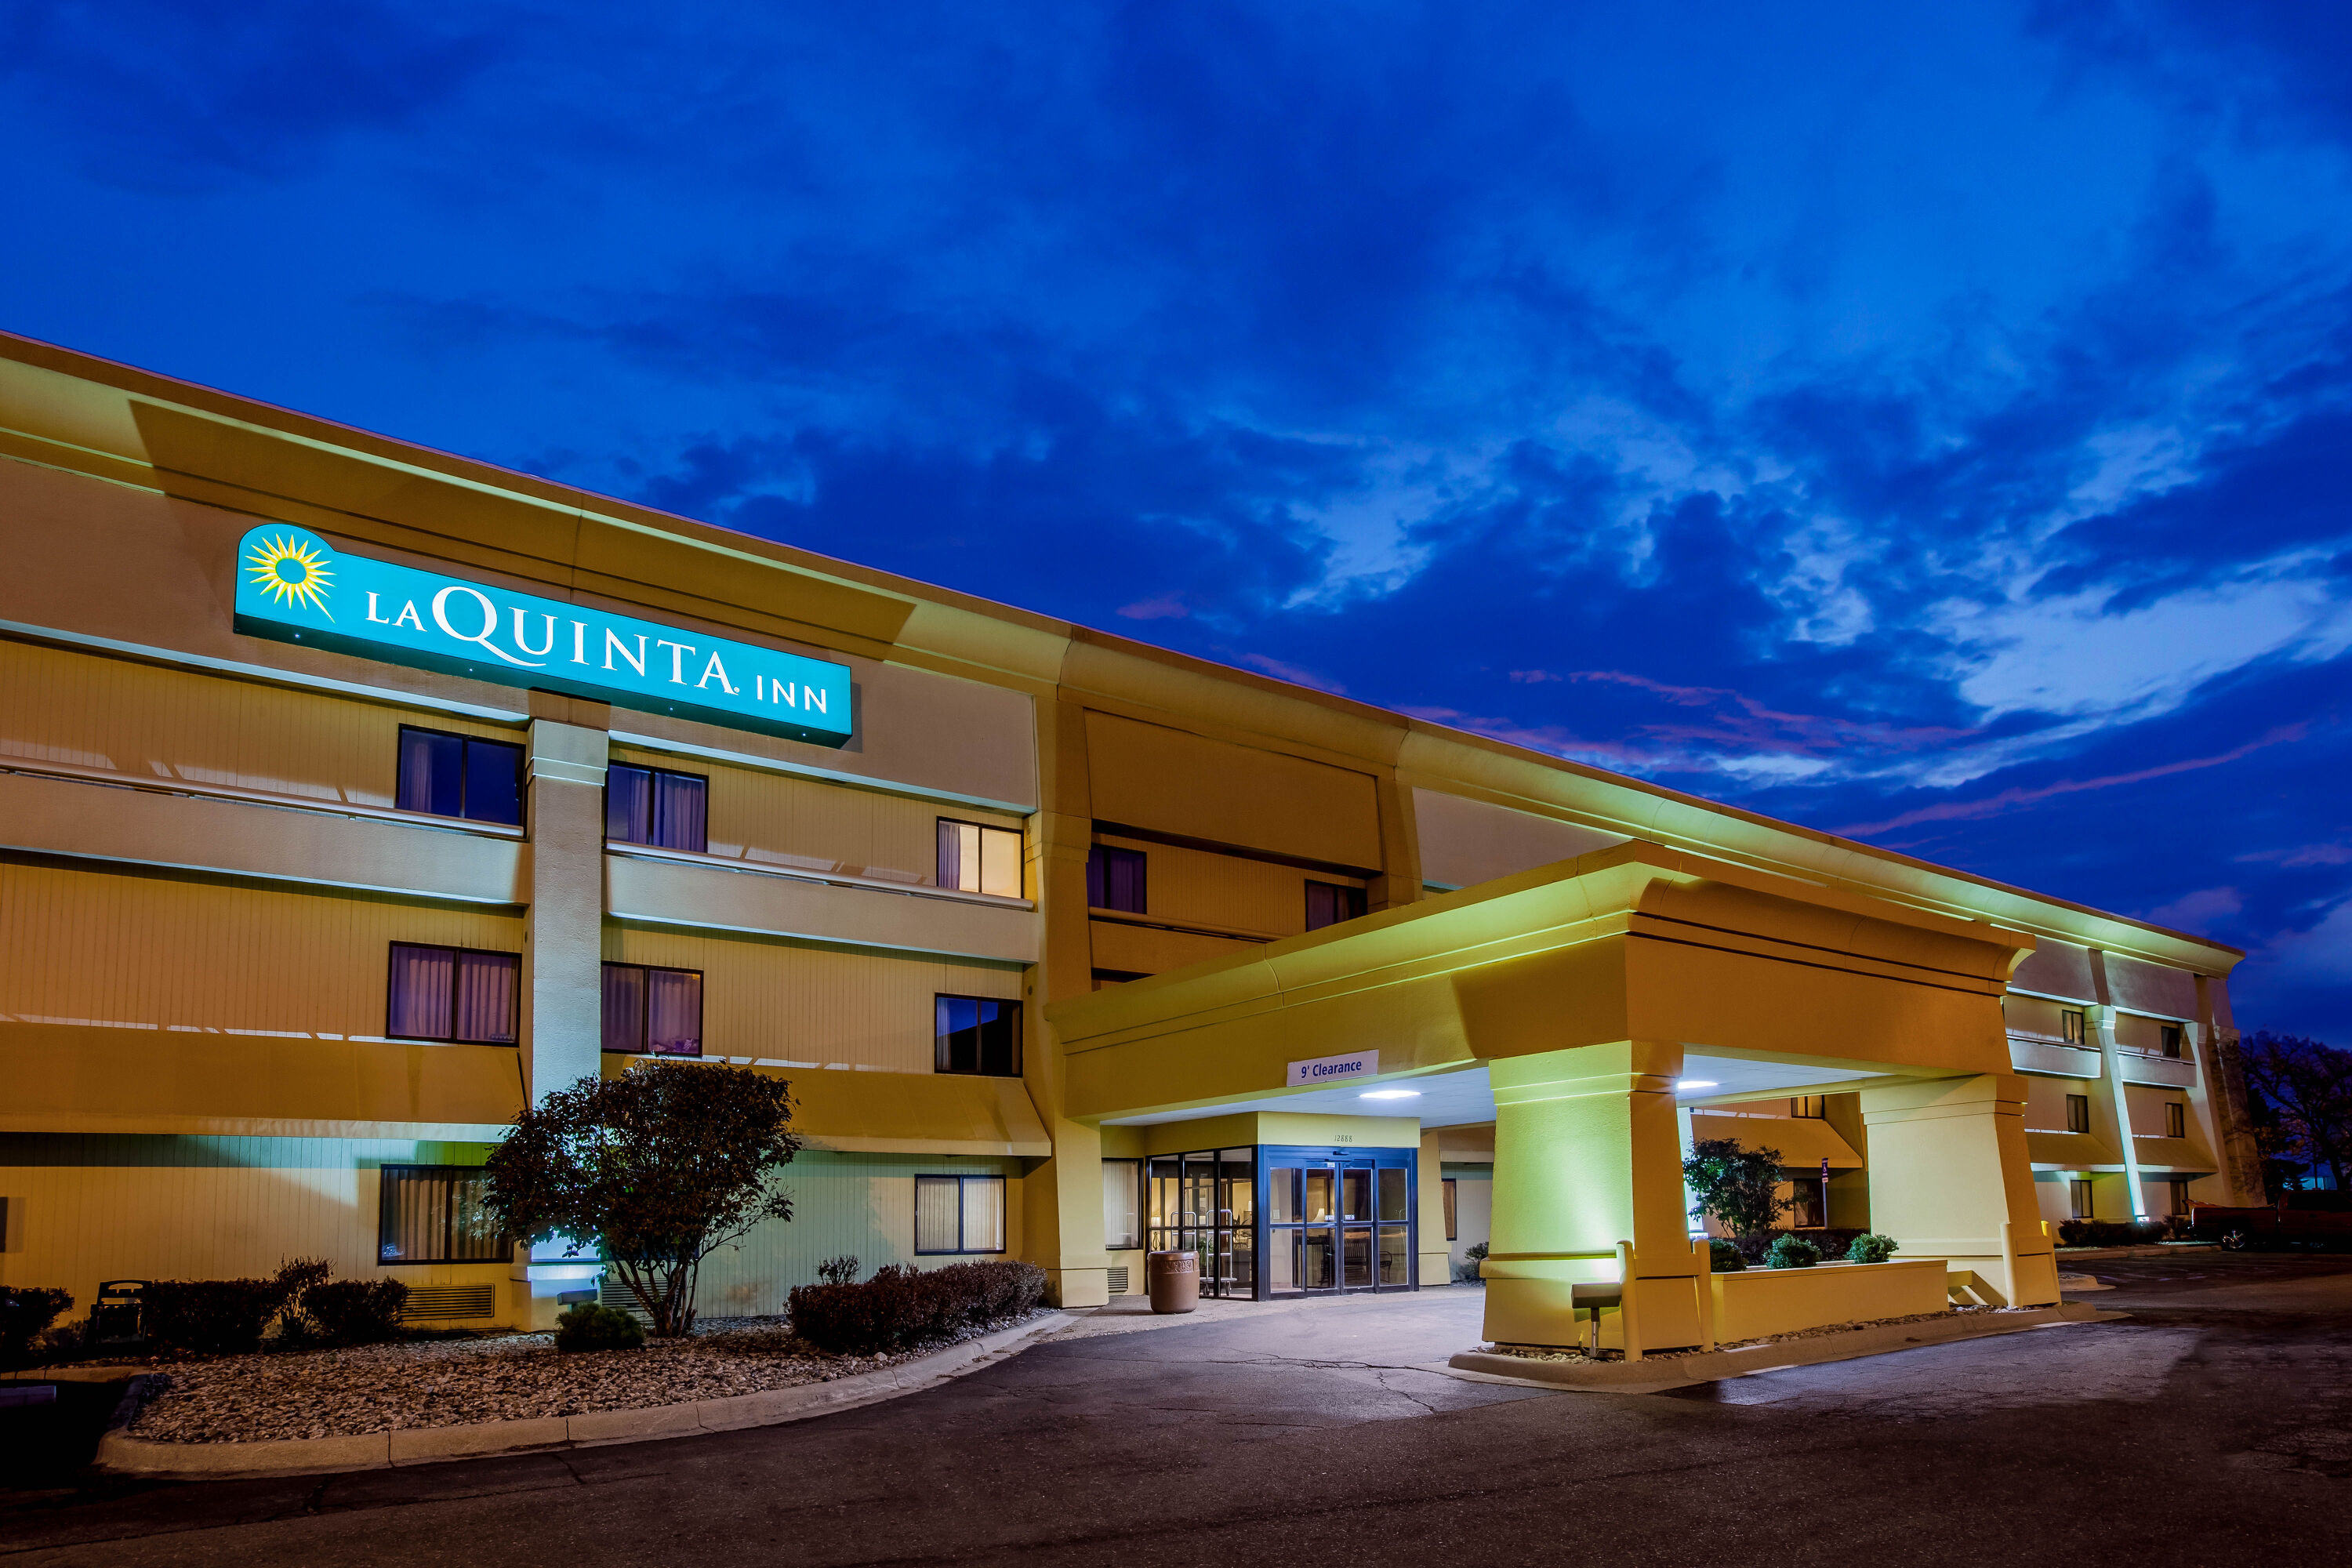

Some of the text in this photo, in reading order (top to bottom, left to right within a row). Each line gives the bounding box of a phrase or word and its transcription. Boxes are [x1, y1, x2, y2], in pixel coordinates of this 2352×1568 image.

[365, 586, 826, 713] LA QUINTA INN
[1301, 1061, 1362, 1079] 9' Clearance
